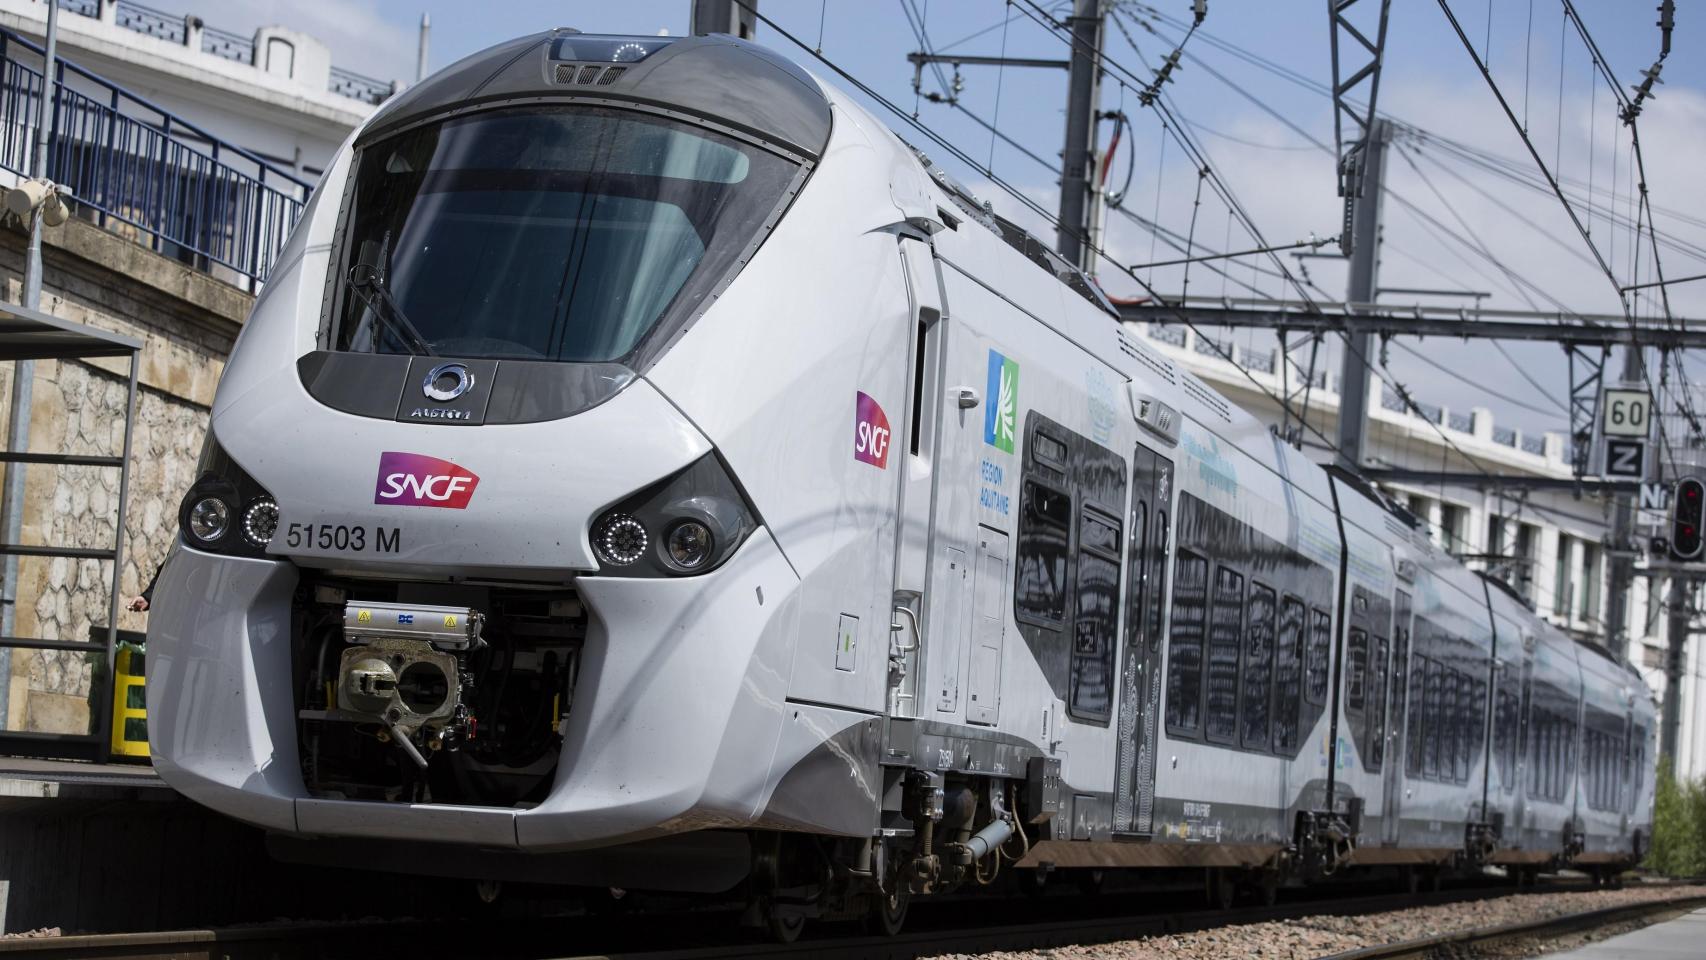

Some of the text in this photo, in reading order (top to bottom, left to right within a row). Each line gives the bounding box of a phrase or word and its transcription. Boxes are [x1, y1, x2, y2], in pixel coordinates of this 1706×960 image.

[1611, 399, 1643, 426] 60
[856, 420, 889, 459] SNCF
[1612, 445, 1638, 472] Z
[379, 473, 472, 501] SNCF
[979, 487, 1009, 515] AQUITAINE
[286, 522, 401, 553] 51503 M
